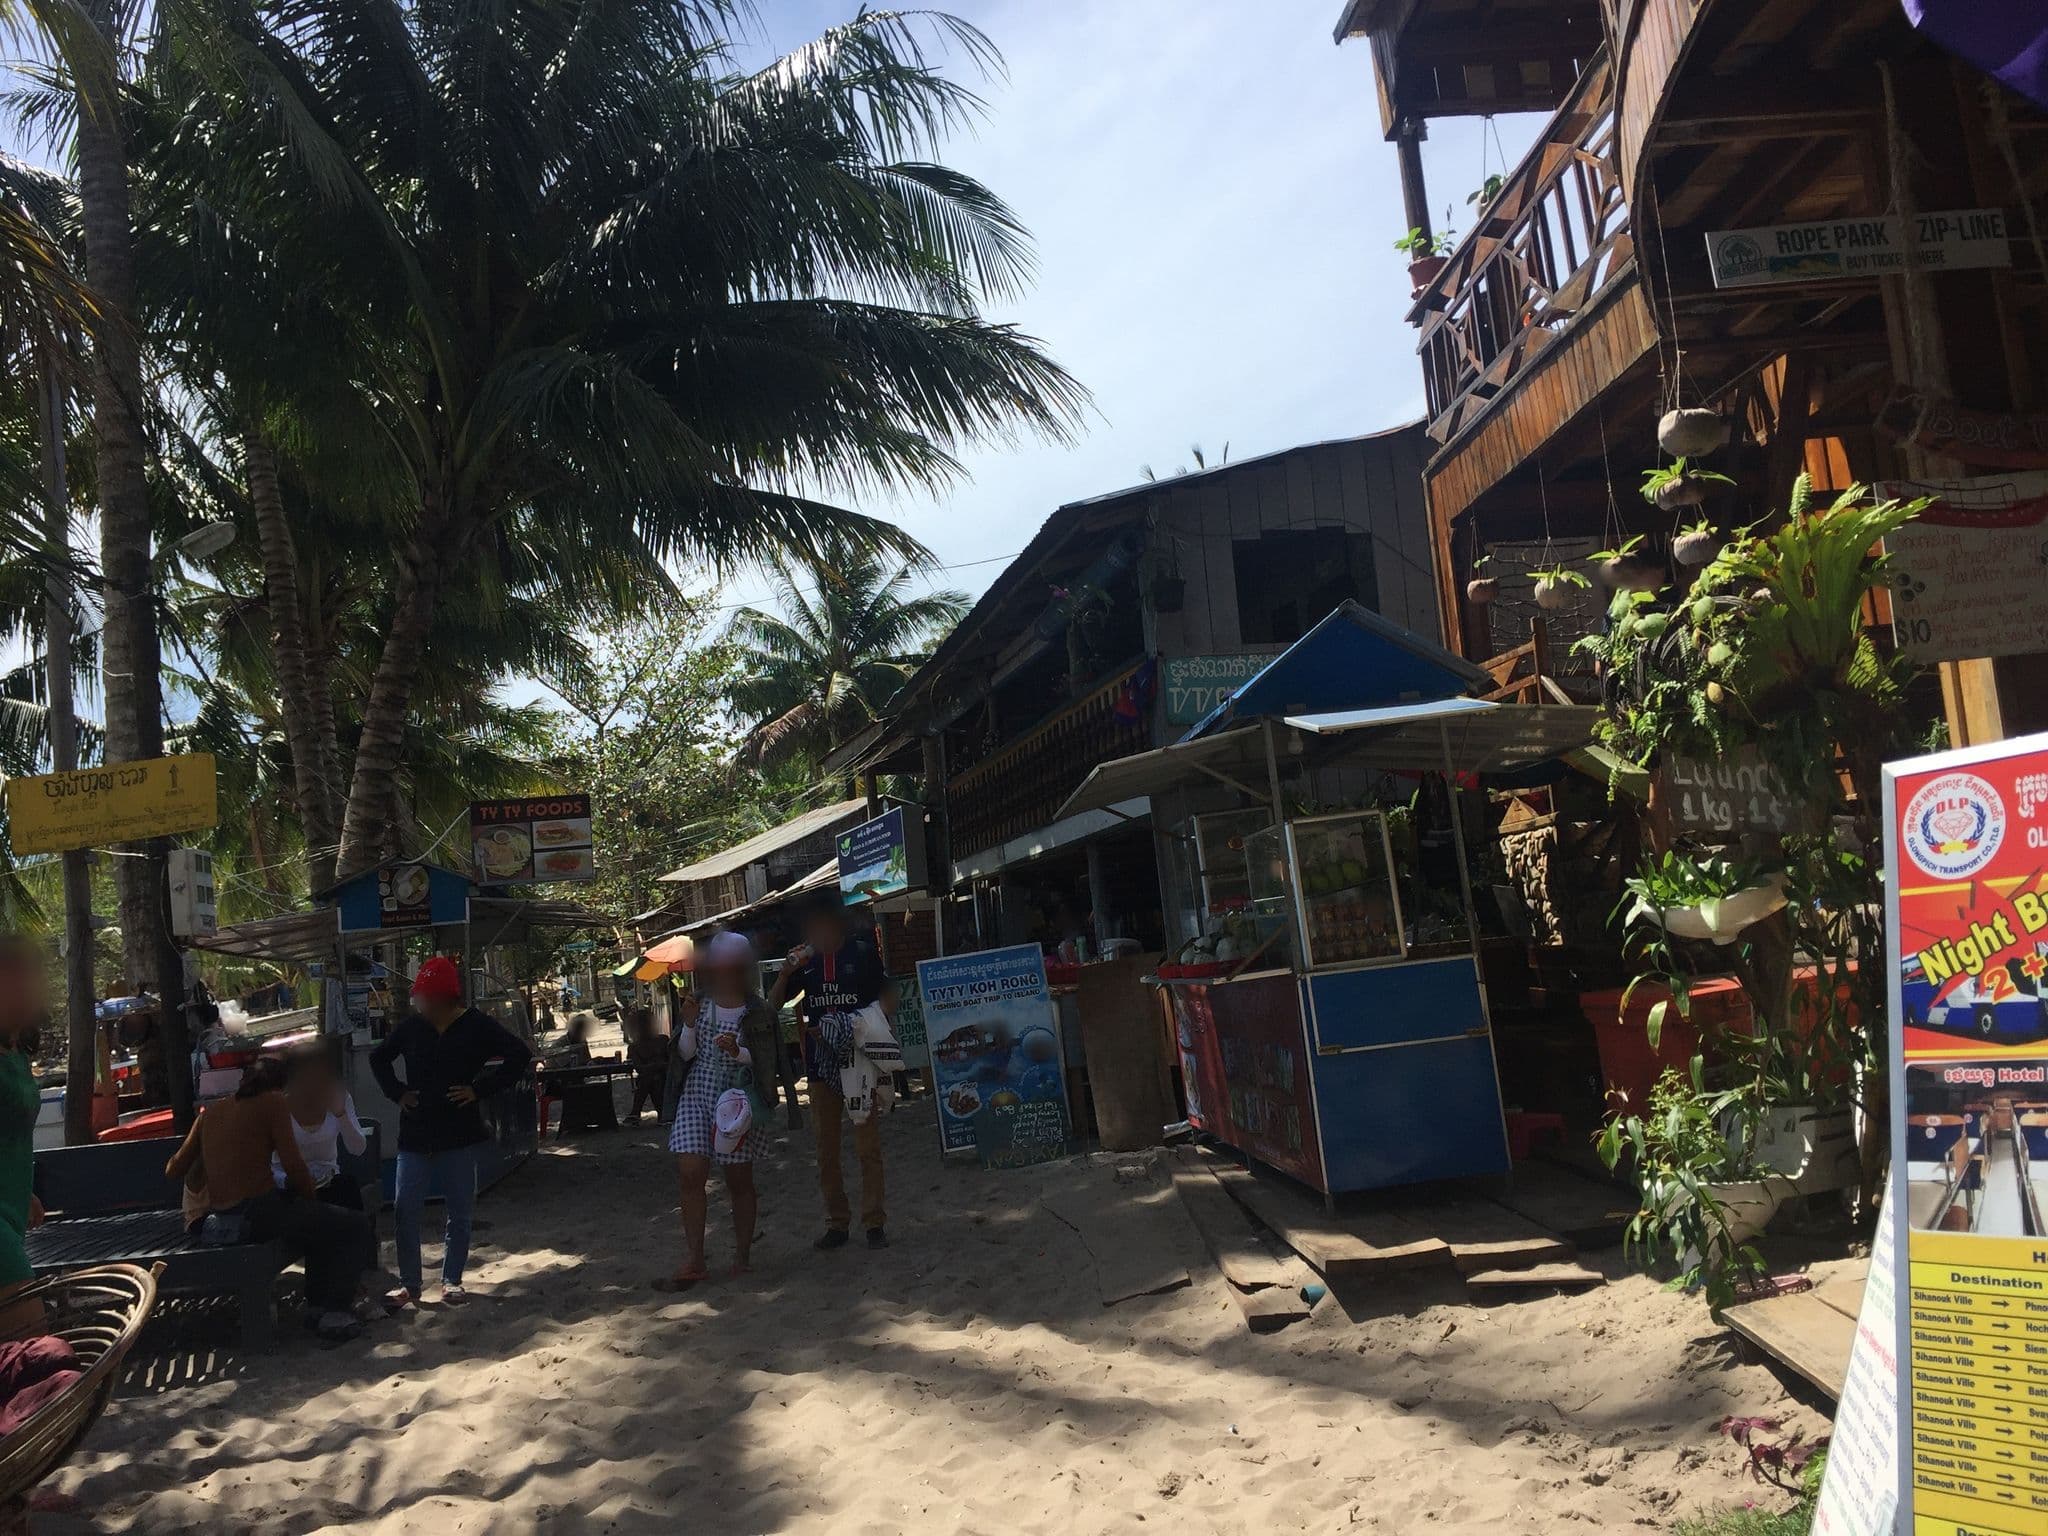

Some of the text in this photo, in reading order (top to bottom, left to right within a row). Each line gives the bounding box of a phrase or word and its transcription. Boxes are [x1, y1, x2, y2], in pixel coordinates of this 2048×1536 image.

[1776, 213, 2005, 254] ROPE PARK ZIP-LINE
[1846, 256, 1868, 275] BUY
[1871, 253, 1904, 272] TICKE
[1896, 617, 1932, 648] $10
[526, 801, 583, 819] FOODS
[1936, 797, 1970, 815] OLP
[2027, 826, 2048, 848] OL
[1908, 836, 1938, 872] OLONGPICH
[1939, 855, 1984, 874] TRANSPORT
[1918, 909, 2018, 987] Night
[823, 983, 839, 992] Fly
[929, 984, 966, 1002] TYTY
[969, 978, 997, 996] KOH
[1000, 974, 1039, 991] RONG
[1984, 966, 2017, 1005] 2
[809, 993, 858, 1009] Emirates
[932, 988, 1041, 1012] FISHING BOAT TRIP TO ISLAND
[1998, 1067, 2045, 1083] Hotel
[2033, 1251, 2048, 1264] H
[1951, 1273, 2043, 1290] Destination
[1914, 1291, 1951, 1303] Sihanouk
[1954, 1295, 1973, 1306] Ville
[1914, 1311, 1952, 1324] Sihanouk
[1954, 1315, 1973, 1326] Ville
[1914, 1331, 2048, 1355] Sihanouk Ville Siem
[1915, 1351, 1953, 1365] Sihanouk
[1955, 1356, 1975, 1368] Ville
[1915, 1371, 2048, 1398] Sihanouk Ville Batt
[1916, 1392, 1954, 1406] Sihanouk
[1956, 1397, 1976, 1410] Ville
[1916, 1412, 1955, 1427] Sihanouk
[1957, 1418, 1977, 1431] Ville
[1917, 1433, 1955, 1447] Sihanouk
[1957, 1438, 1977, 1452] Ville
[1917, 1454, 2048, 1486] Sihanouk Ville Patt
[1917, 1475, 1956, 1489] Sihanouk
[1957, 1480, 1979, 1494] Ville
